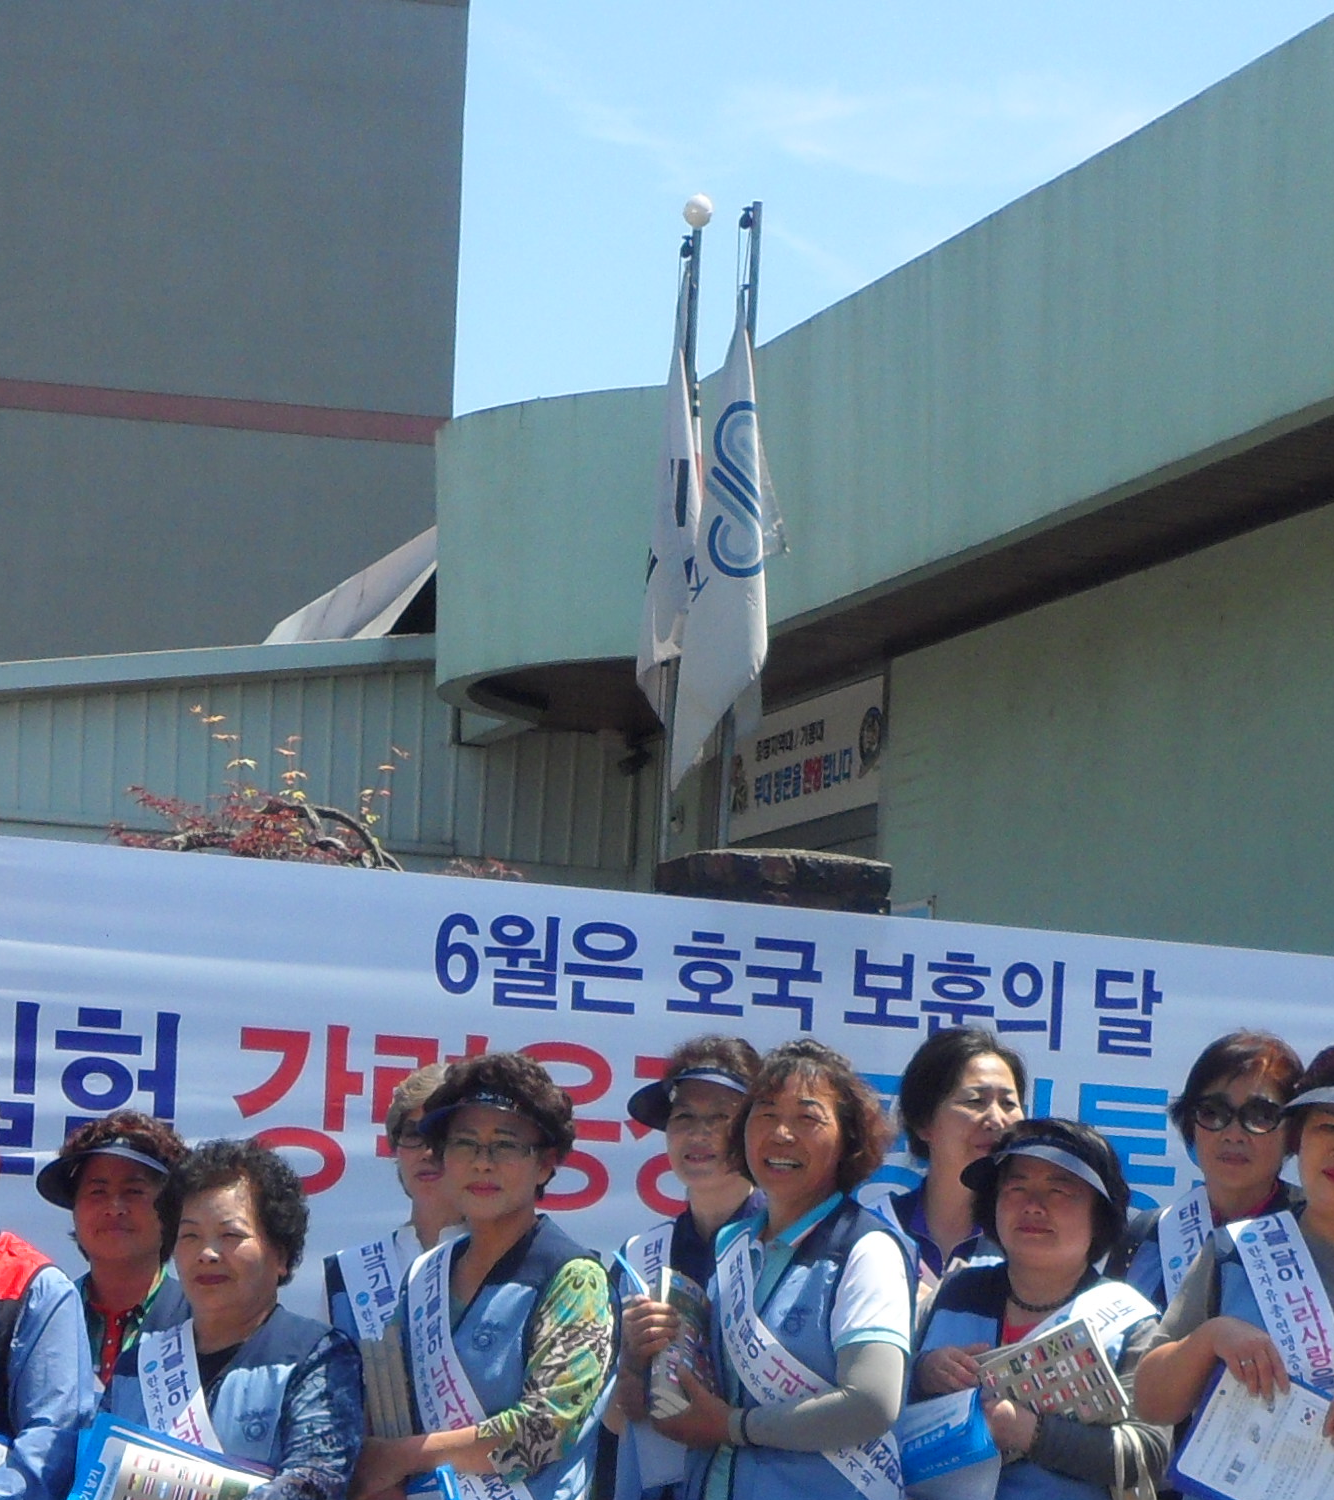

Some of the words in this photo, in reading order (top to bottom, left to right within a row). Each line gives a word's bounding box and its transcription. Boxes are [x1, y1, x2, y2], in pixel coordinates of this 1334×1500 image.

[434, 911, 645, 1016] 6월은
[666, 930, 823, 1032] 호국
[843, 948, 1066, 1051] 보훈의
[1093, 966, 1163, 1058] 달
[359, 1240, 397, 1308] 태극기를
[1270, 1242, 1307, 1282] 달아
[163, 1370, 193, 1408] 달아
